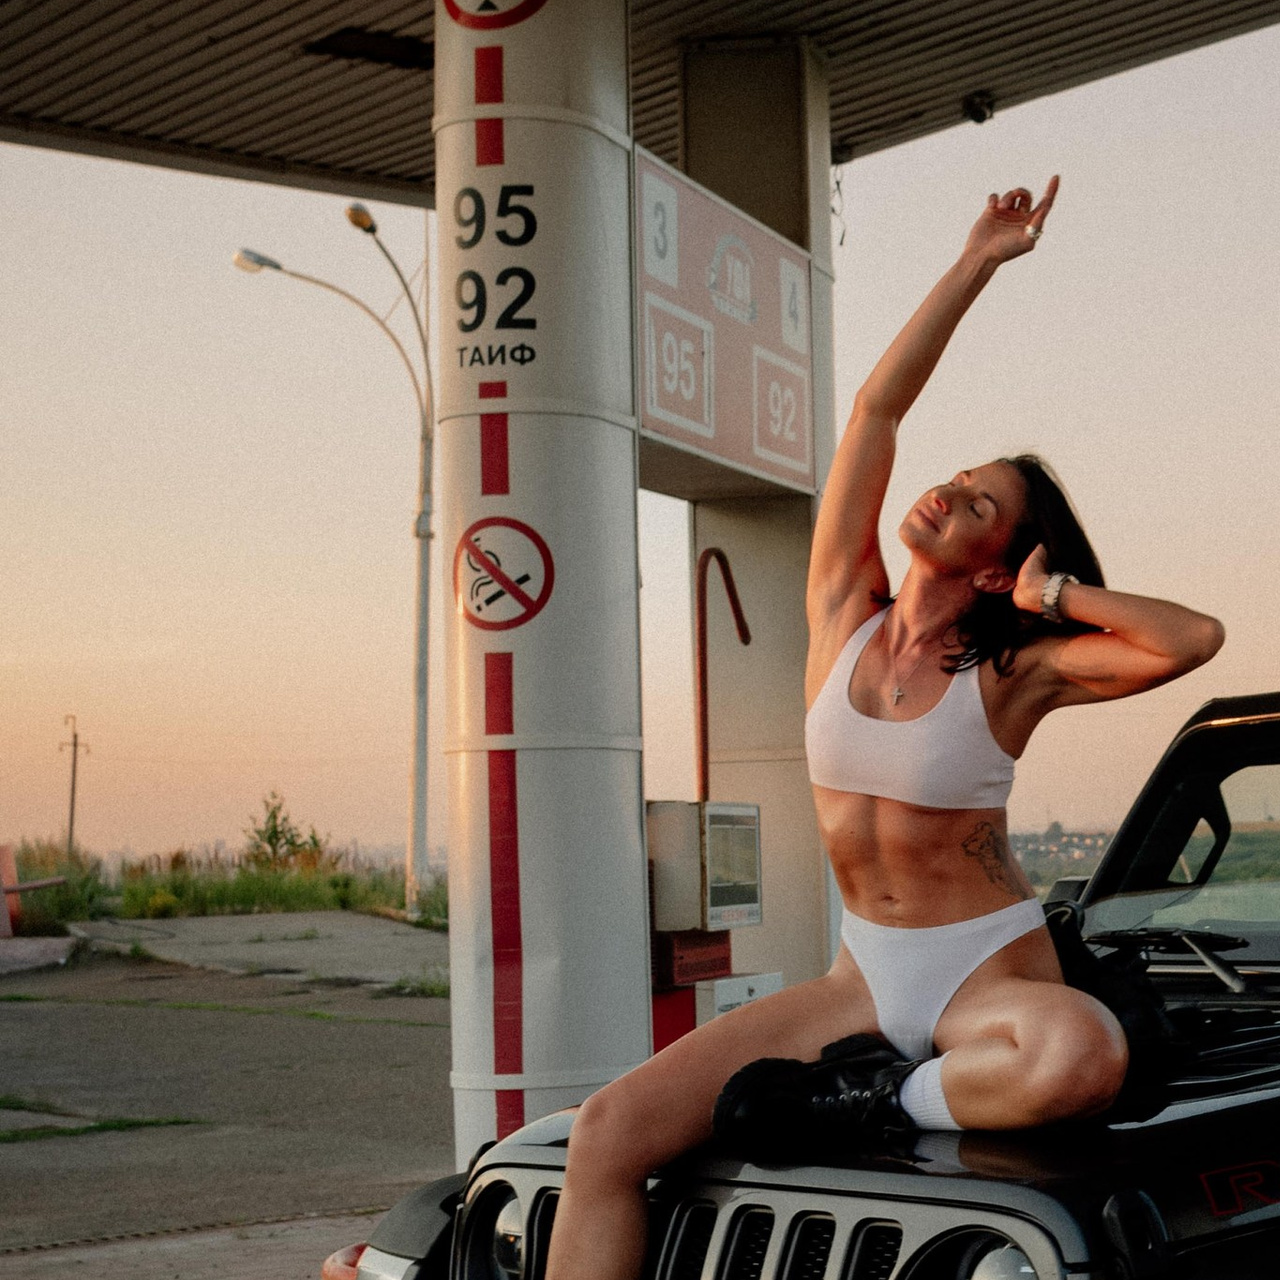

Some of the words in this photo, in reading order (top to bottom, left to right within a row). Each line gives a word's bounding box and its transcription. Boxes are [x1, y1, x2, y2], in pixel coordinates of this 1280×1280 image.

[453, 184, 538, 250] 95
[652, 200, 669, 261] 3
[455, 266, 538, 332] 92
[786, 281, 799, 333] 4
[456, 343, 537, 367] ТАИФ
[661, 330, 697, 402] 95
[767, 380, 798, 443] 92
